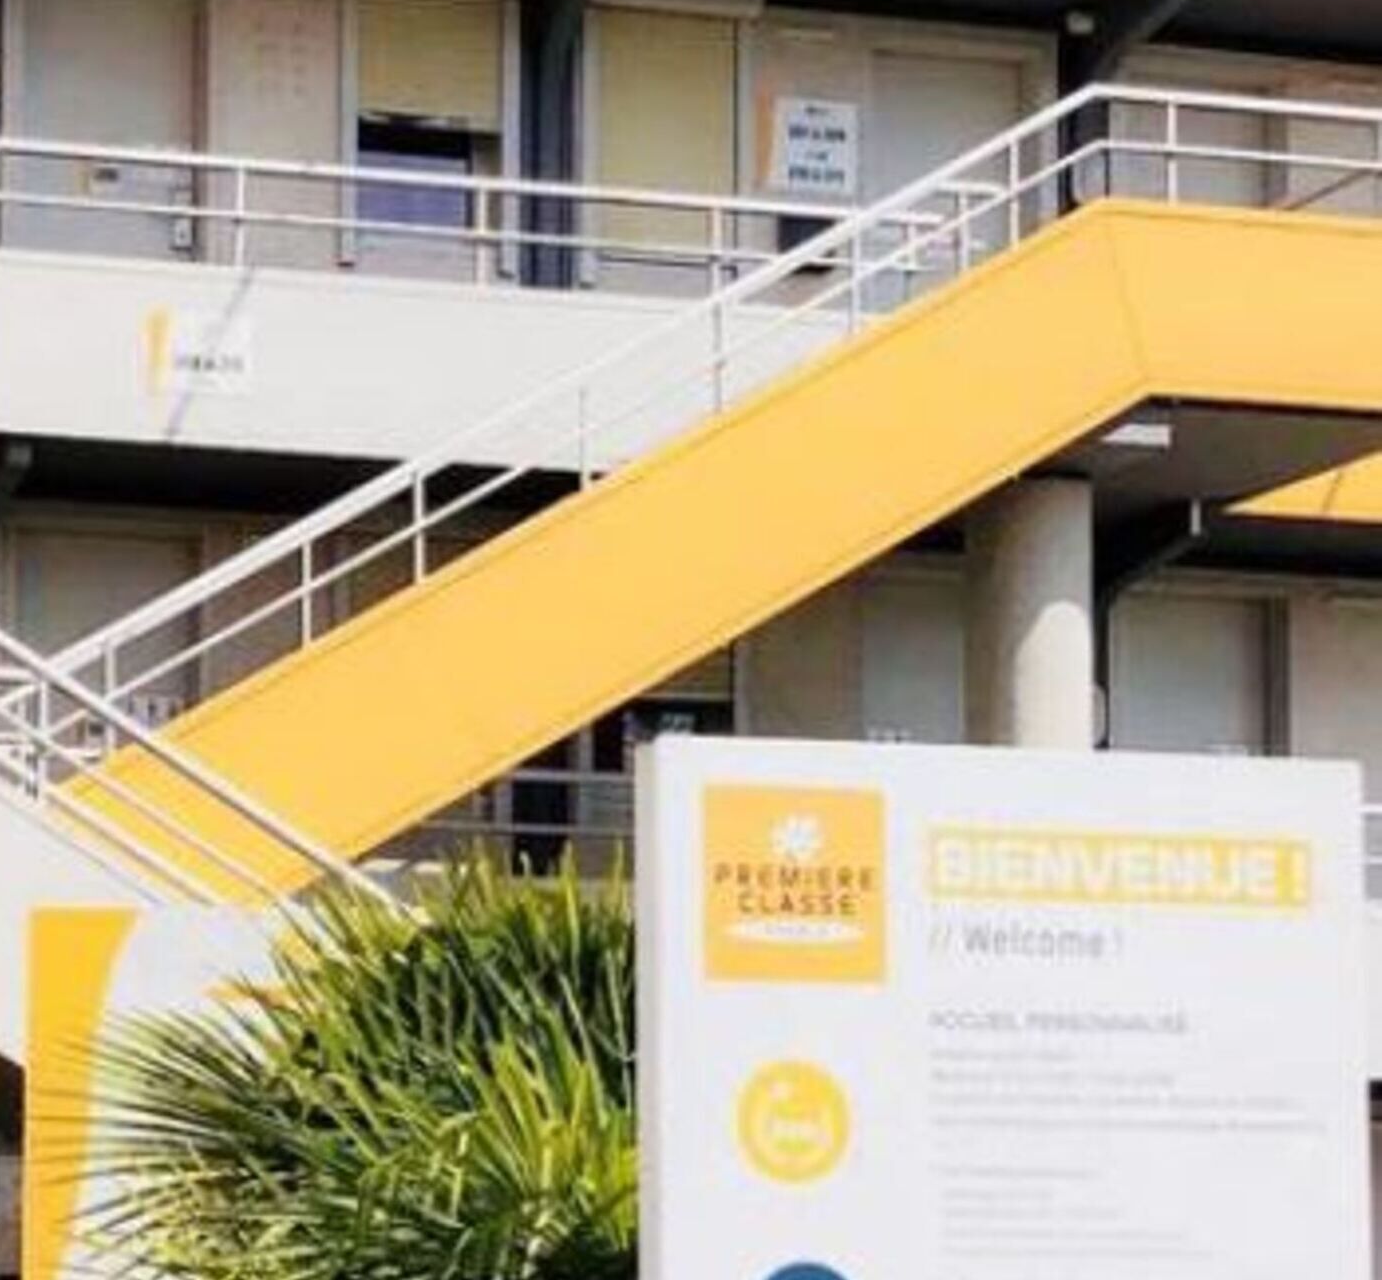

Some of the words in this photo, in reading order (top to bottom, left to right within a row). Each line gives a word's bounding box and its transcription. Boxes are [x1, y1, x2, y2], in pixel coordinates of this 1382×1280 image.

[714, 863, 876, 891] PREMIERE
[936, 837, 1281, 901] BIENVENUE
[738, 892, 858, 916] CLASSE
[964, 922, 1106, 958] Welcome
